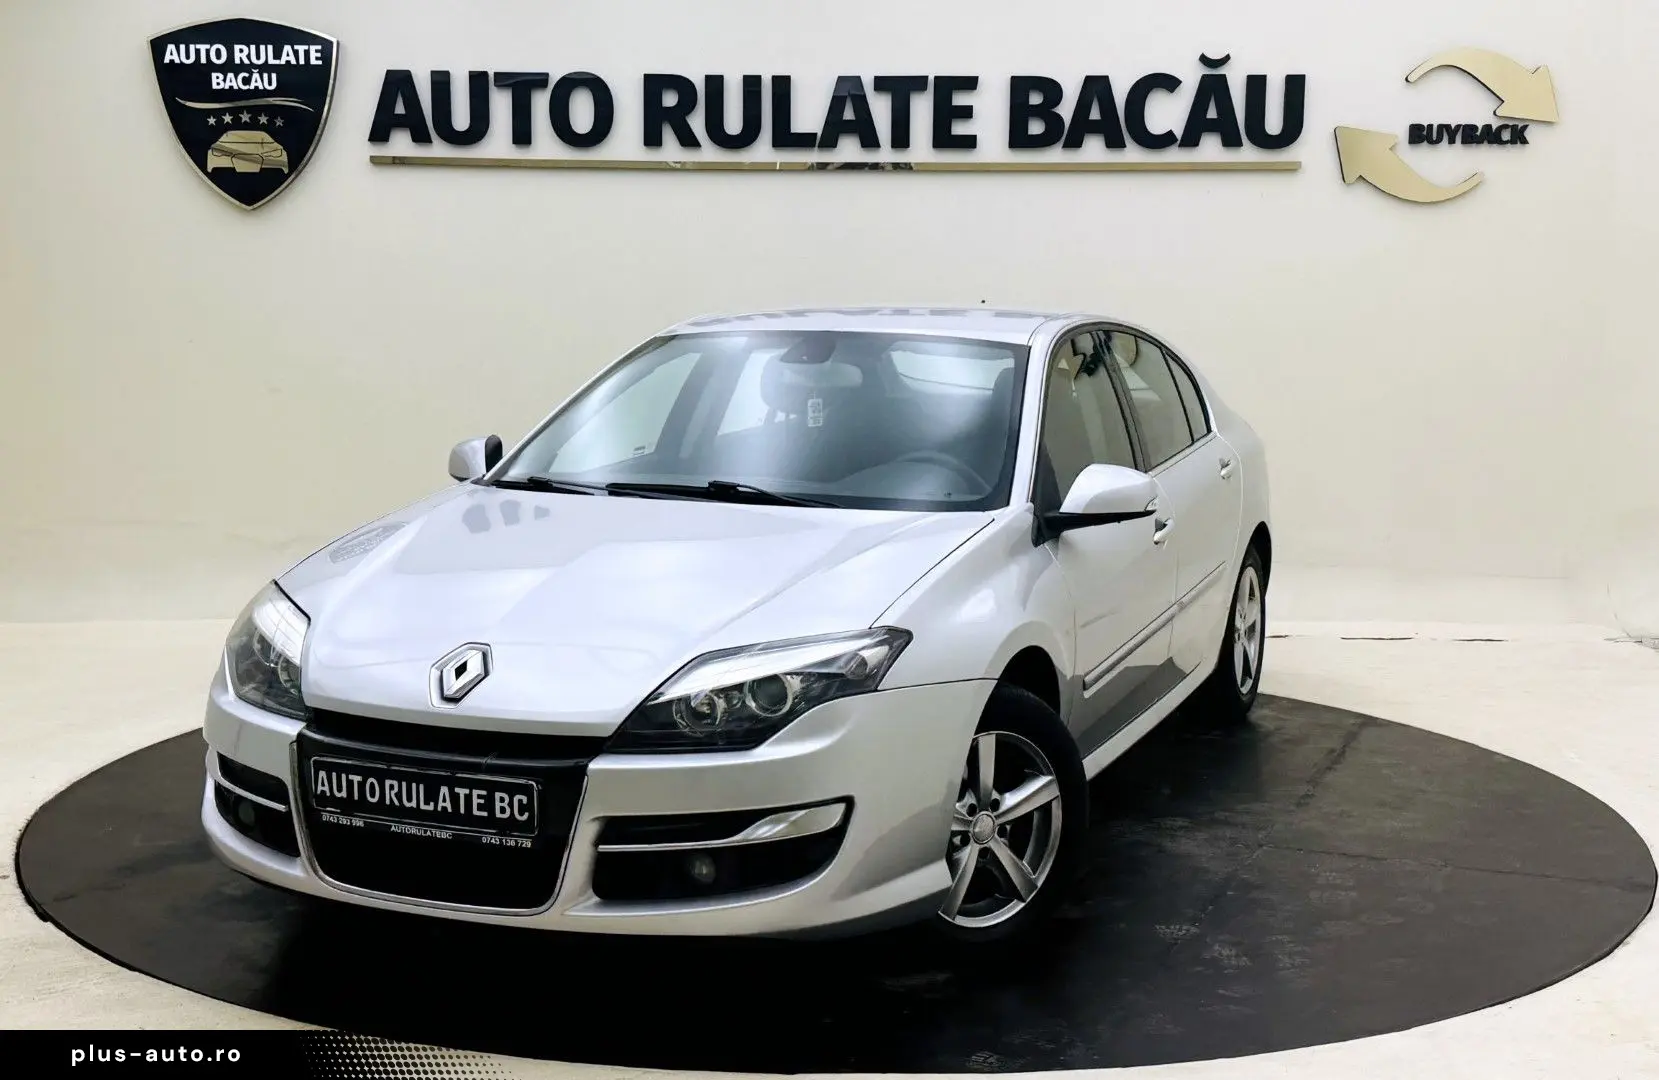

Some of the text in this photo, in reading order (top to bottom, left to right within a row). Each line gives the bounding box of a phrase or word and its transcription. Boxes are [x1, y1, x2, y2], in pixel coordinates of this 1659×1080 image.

[164, 44, 323, 65] AUTO RULATE
[211, 68, 277, 91] BACĂU
[368, 53, 1306, 149] AUTO RULATE BACĂU
[1408, 123, 1529, 145] BUYBACK
[316, 770, 529, 822] AUTO RULATE BC
[390, 824, 453, 840] AUTORULATEBC
[481, 836, 500, 845] 0743
[517, 840, 532, 848] 729
